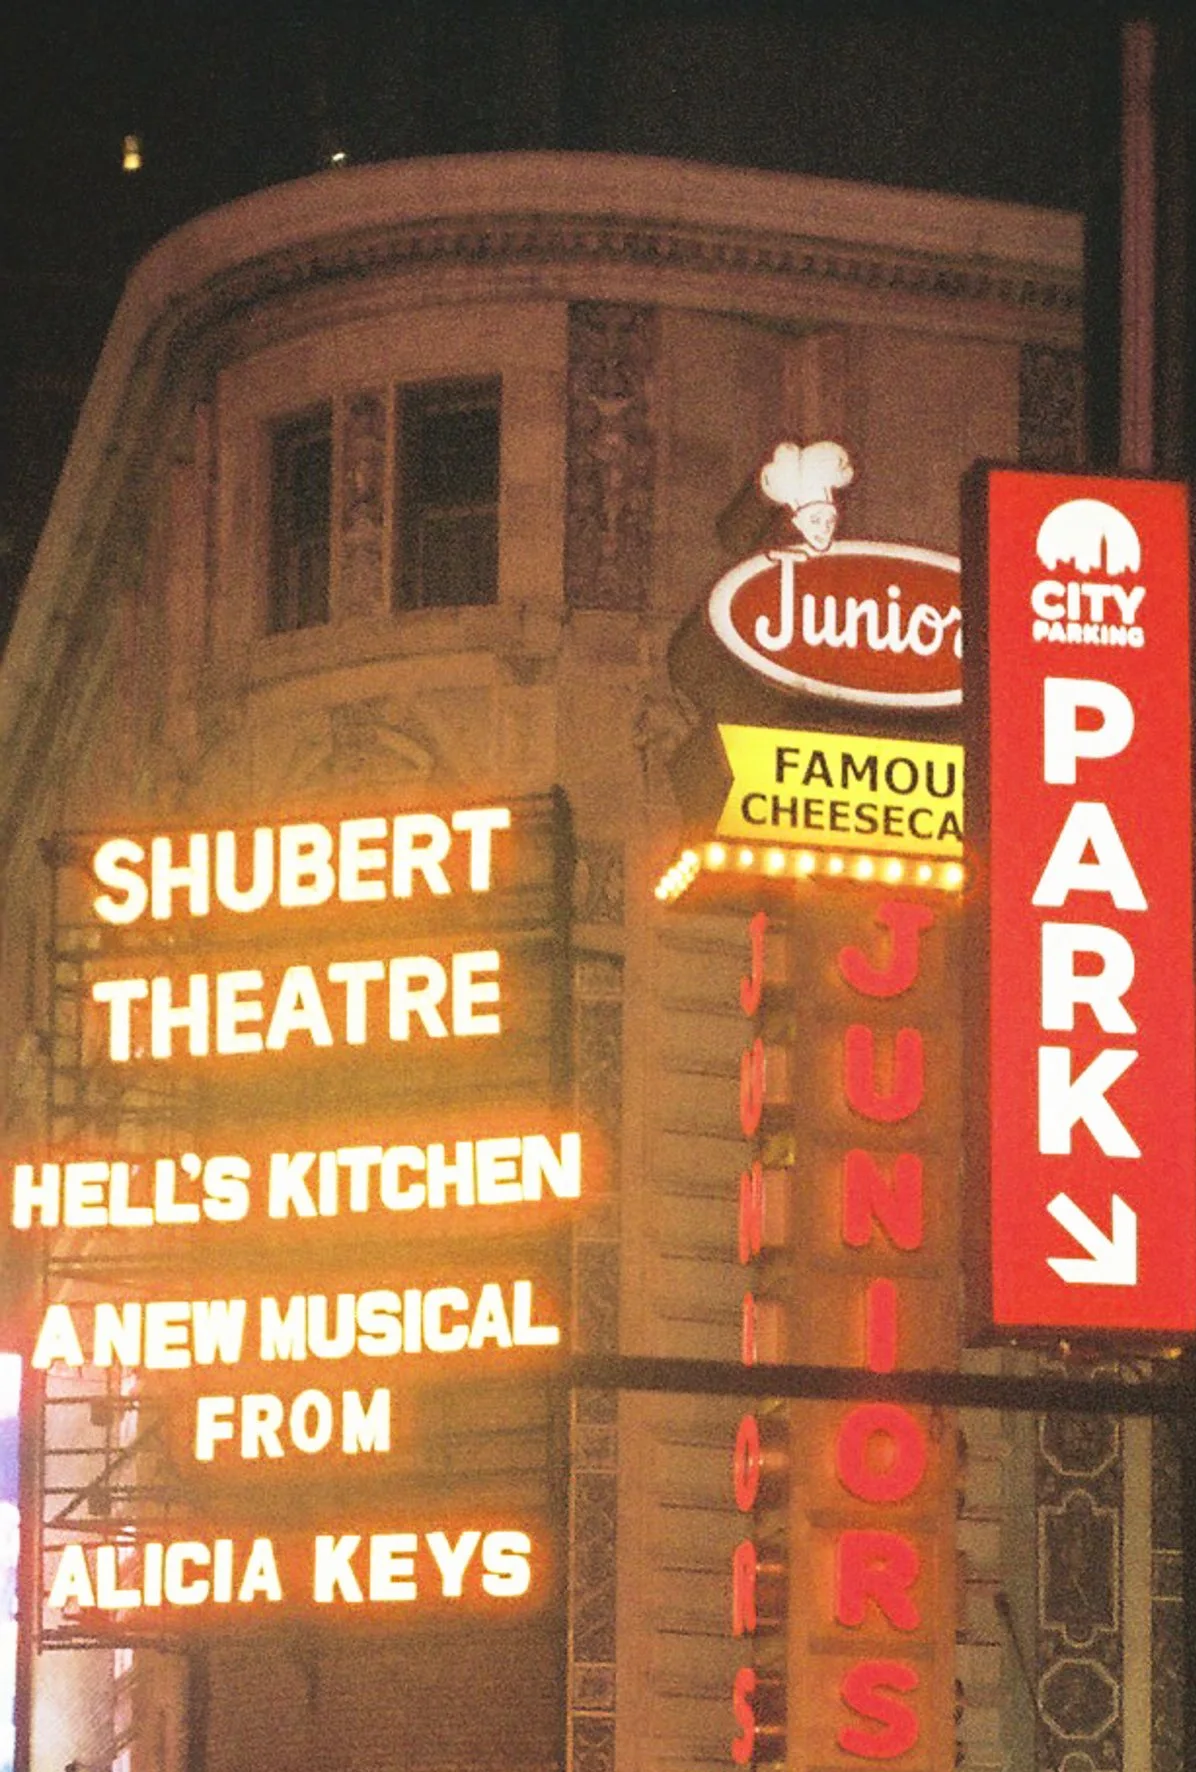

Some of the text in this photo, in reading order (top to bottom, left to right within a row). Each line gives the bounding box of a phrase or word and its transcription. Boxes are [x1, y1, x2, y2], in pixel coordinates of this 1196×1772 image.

[1031, 579, 1146, 624] CITY
[1032, 619, 1145, 648] PARKING
[93, 808, 511, 924] SHUBERT
[1030, 676, 1149, 1158] PARK
[92, 950, 501, 1062] THEATRE
[12, 1132, 581, 1229] HELL'S KITCHEN
[32, 1280, 560, 1369] A NEW MUSICAL
[836, 900, 933, 1759] JUNIORS
[195, 1388, 391, 1461] FROM
[48, 1531, 531, 1609] ALICIA KEYS
